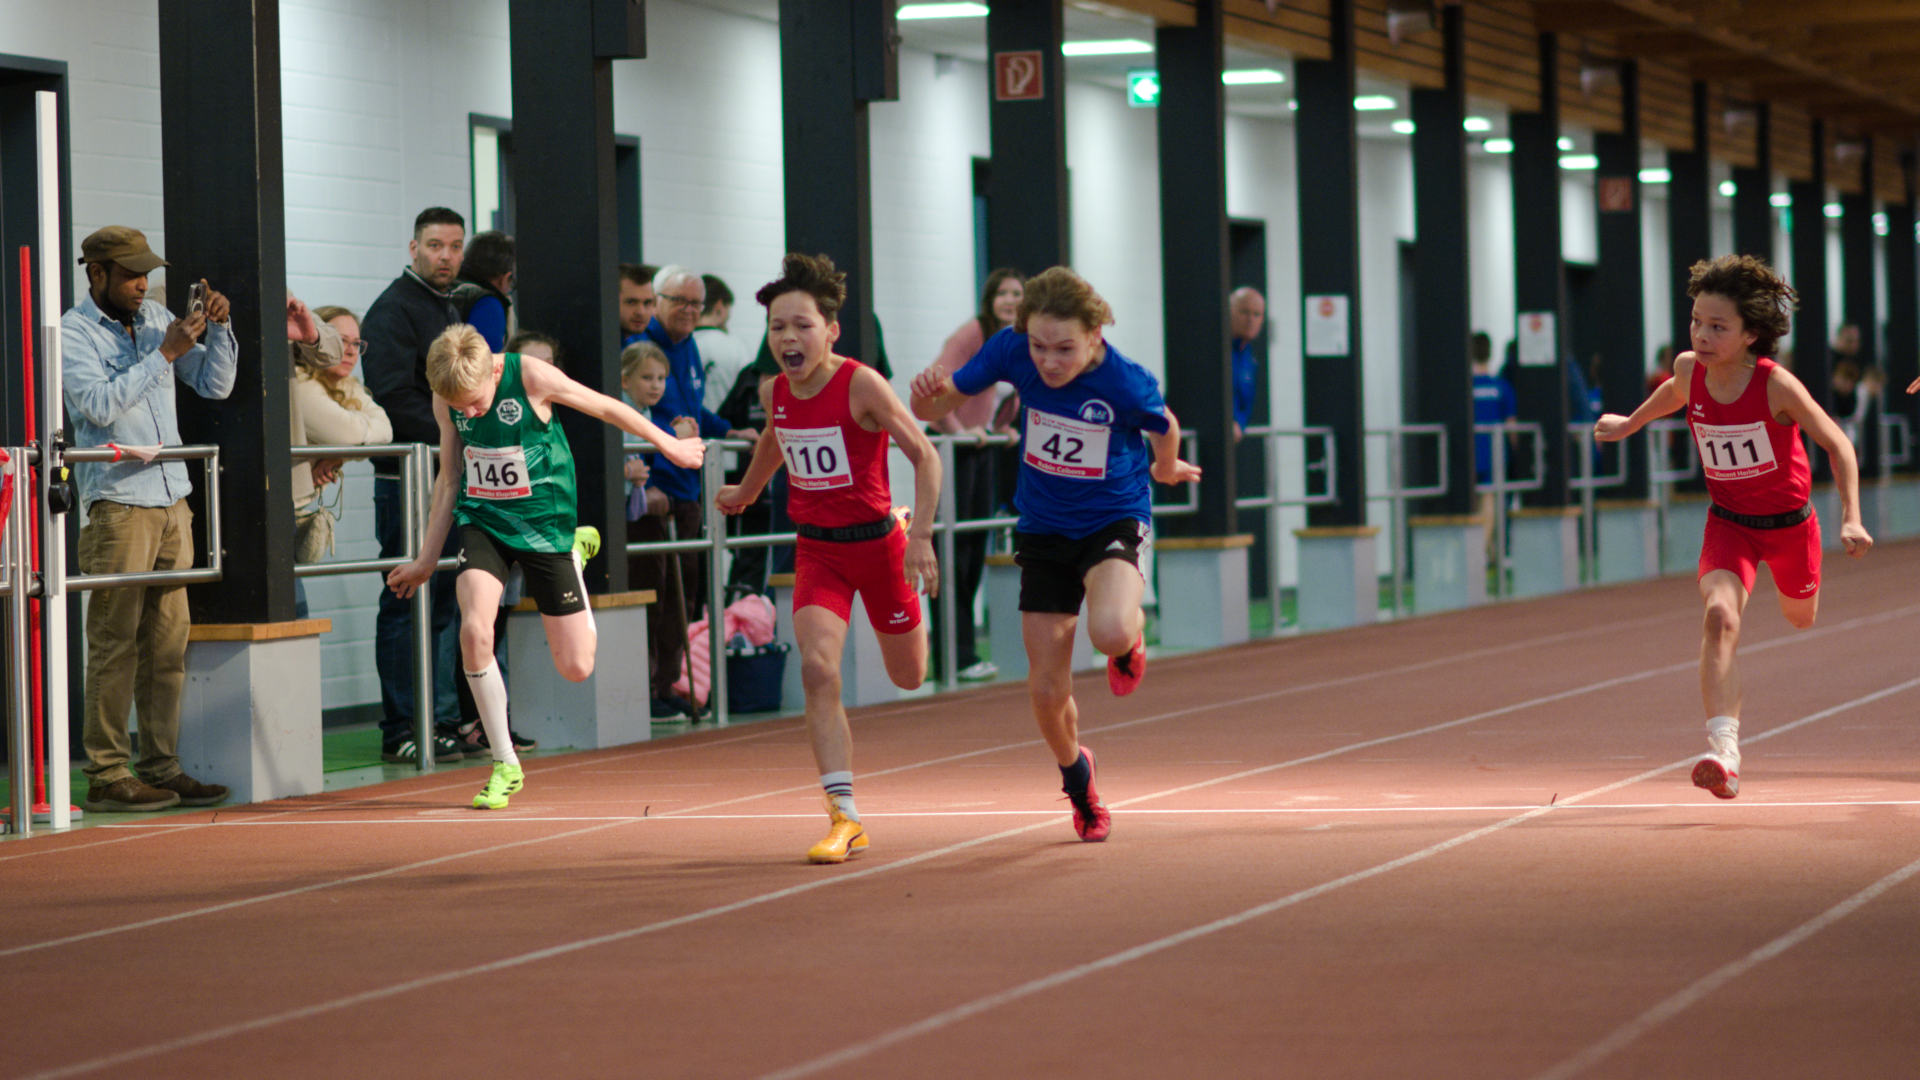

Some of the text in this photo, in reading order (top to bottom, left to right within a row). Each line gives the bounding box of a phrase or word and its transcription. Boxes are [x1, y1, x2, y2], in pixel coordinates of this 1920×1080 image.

[786, 446, 837, 475] 110
[1042, 433, 1084, 463] 42
[1706, 439, 1760, 466] 111
[473, 461, 519, 487] 146
